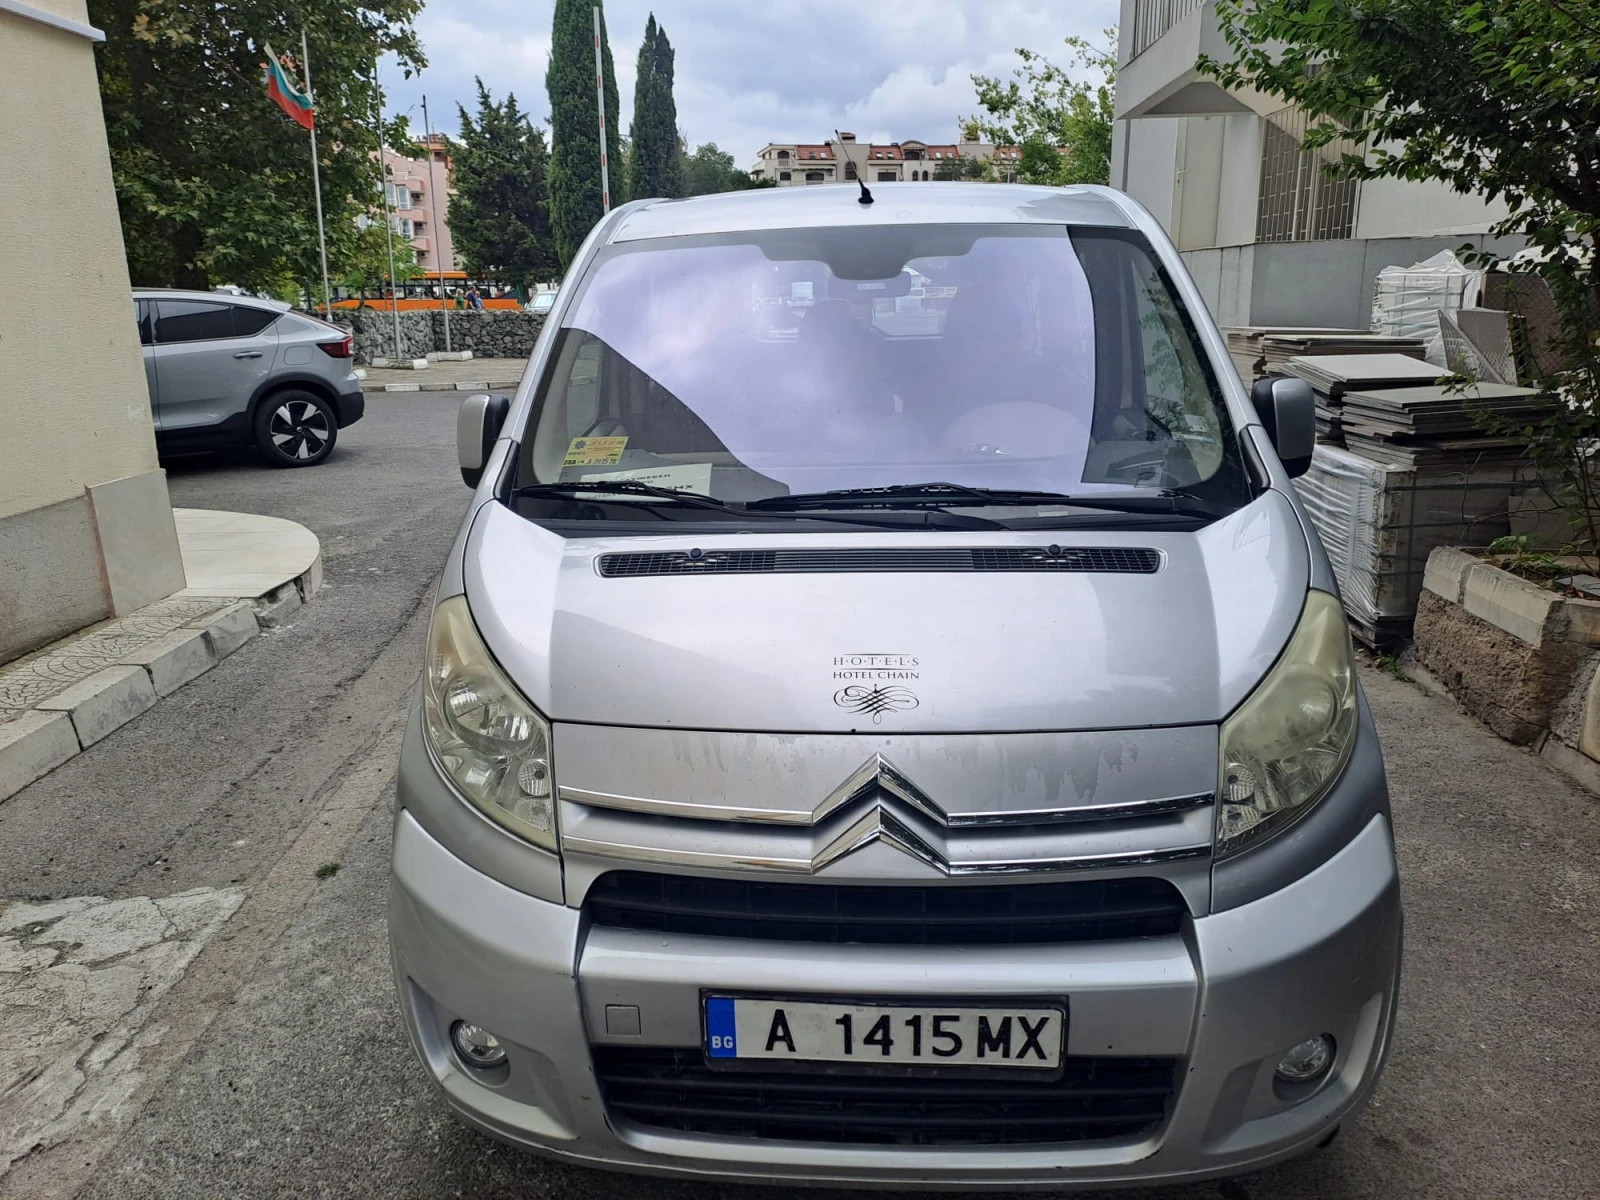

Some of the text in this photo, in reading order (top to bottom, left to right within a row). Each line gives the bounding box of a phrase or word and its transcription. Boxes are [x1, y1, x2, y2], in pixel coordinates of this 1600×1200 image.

[833, 671, 920, 680] HOTEL CHAIN
[765, 1008, 1051, 1060] A 1415 MX
[711, 1035, 734, 1049] BG
